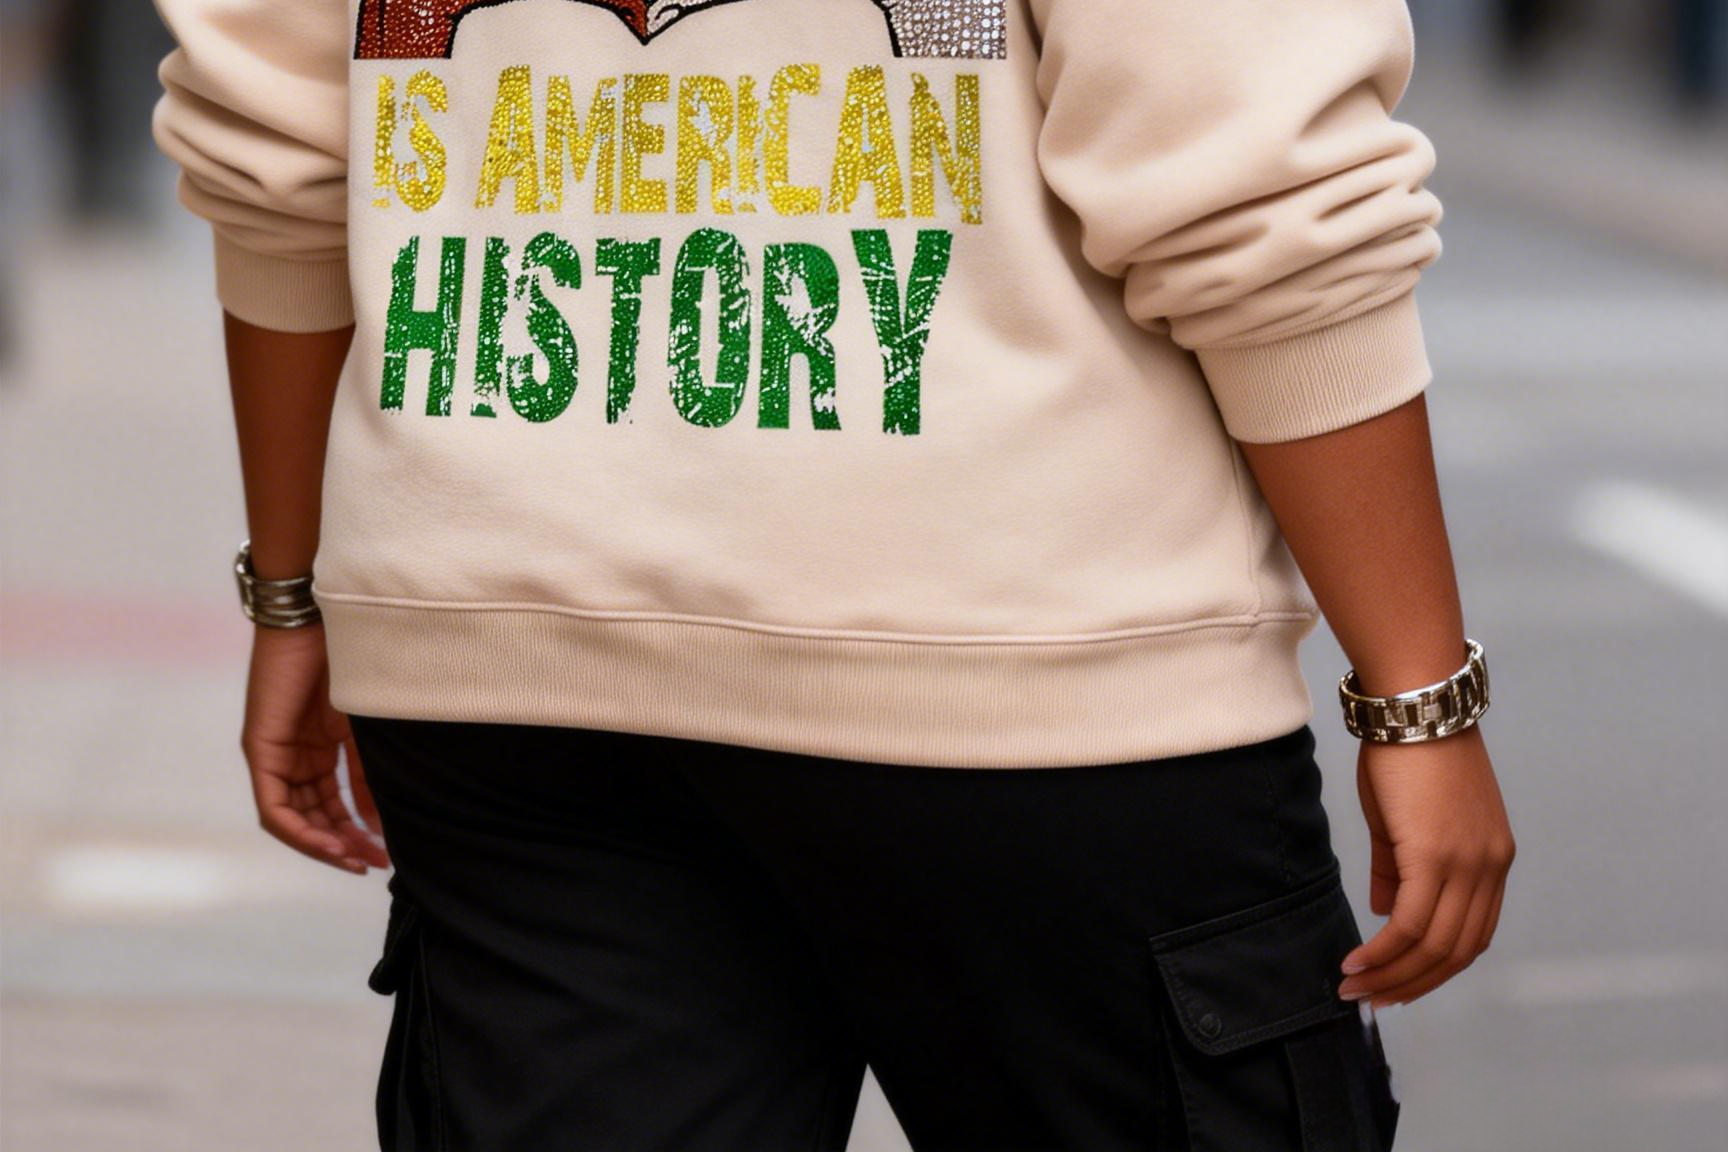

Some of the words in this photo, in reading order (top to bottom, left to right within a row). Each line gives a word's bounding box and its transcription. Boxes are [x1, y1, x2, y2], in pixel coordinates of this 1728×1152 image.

[372, 69, 449, 213] IS
[474, 63, 983, 224] AMERICAN
[379, 227, 953, 435] HISTORY
